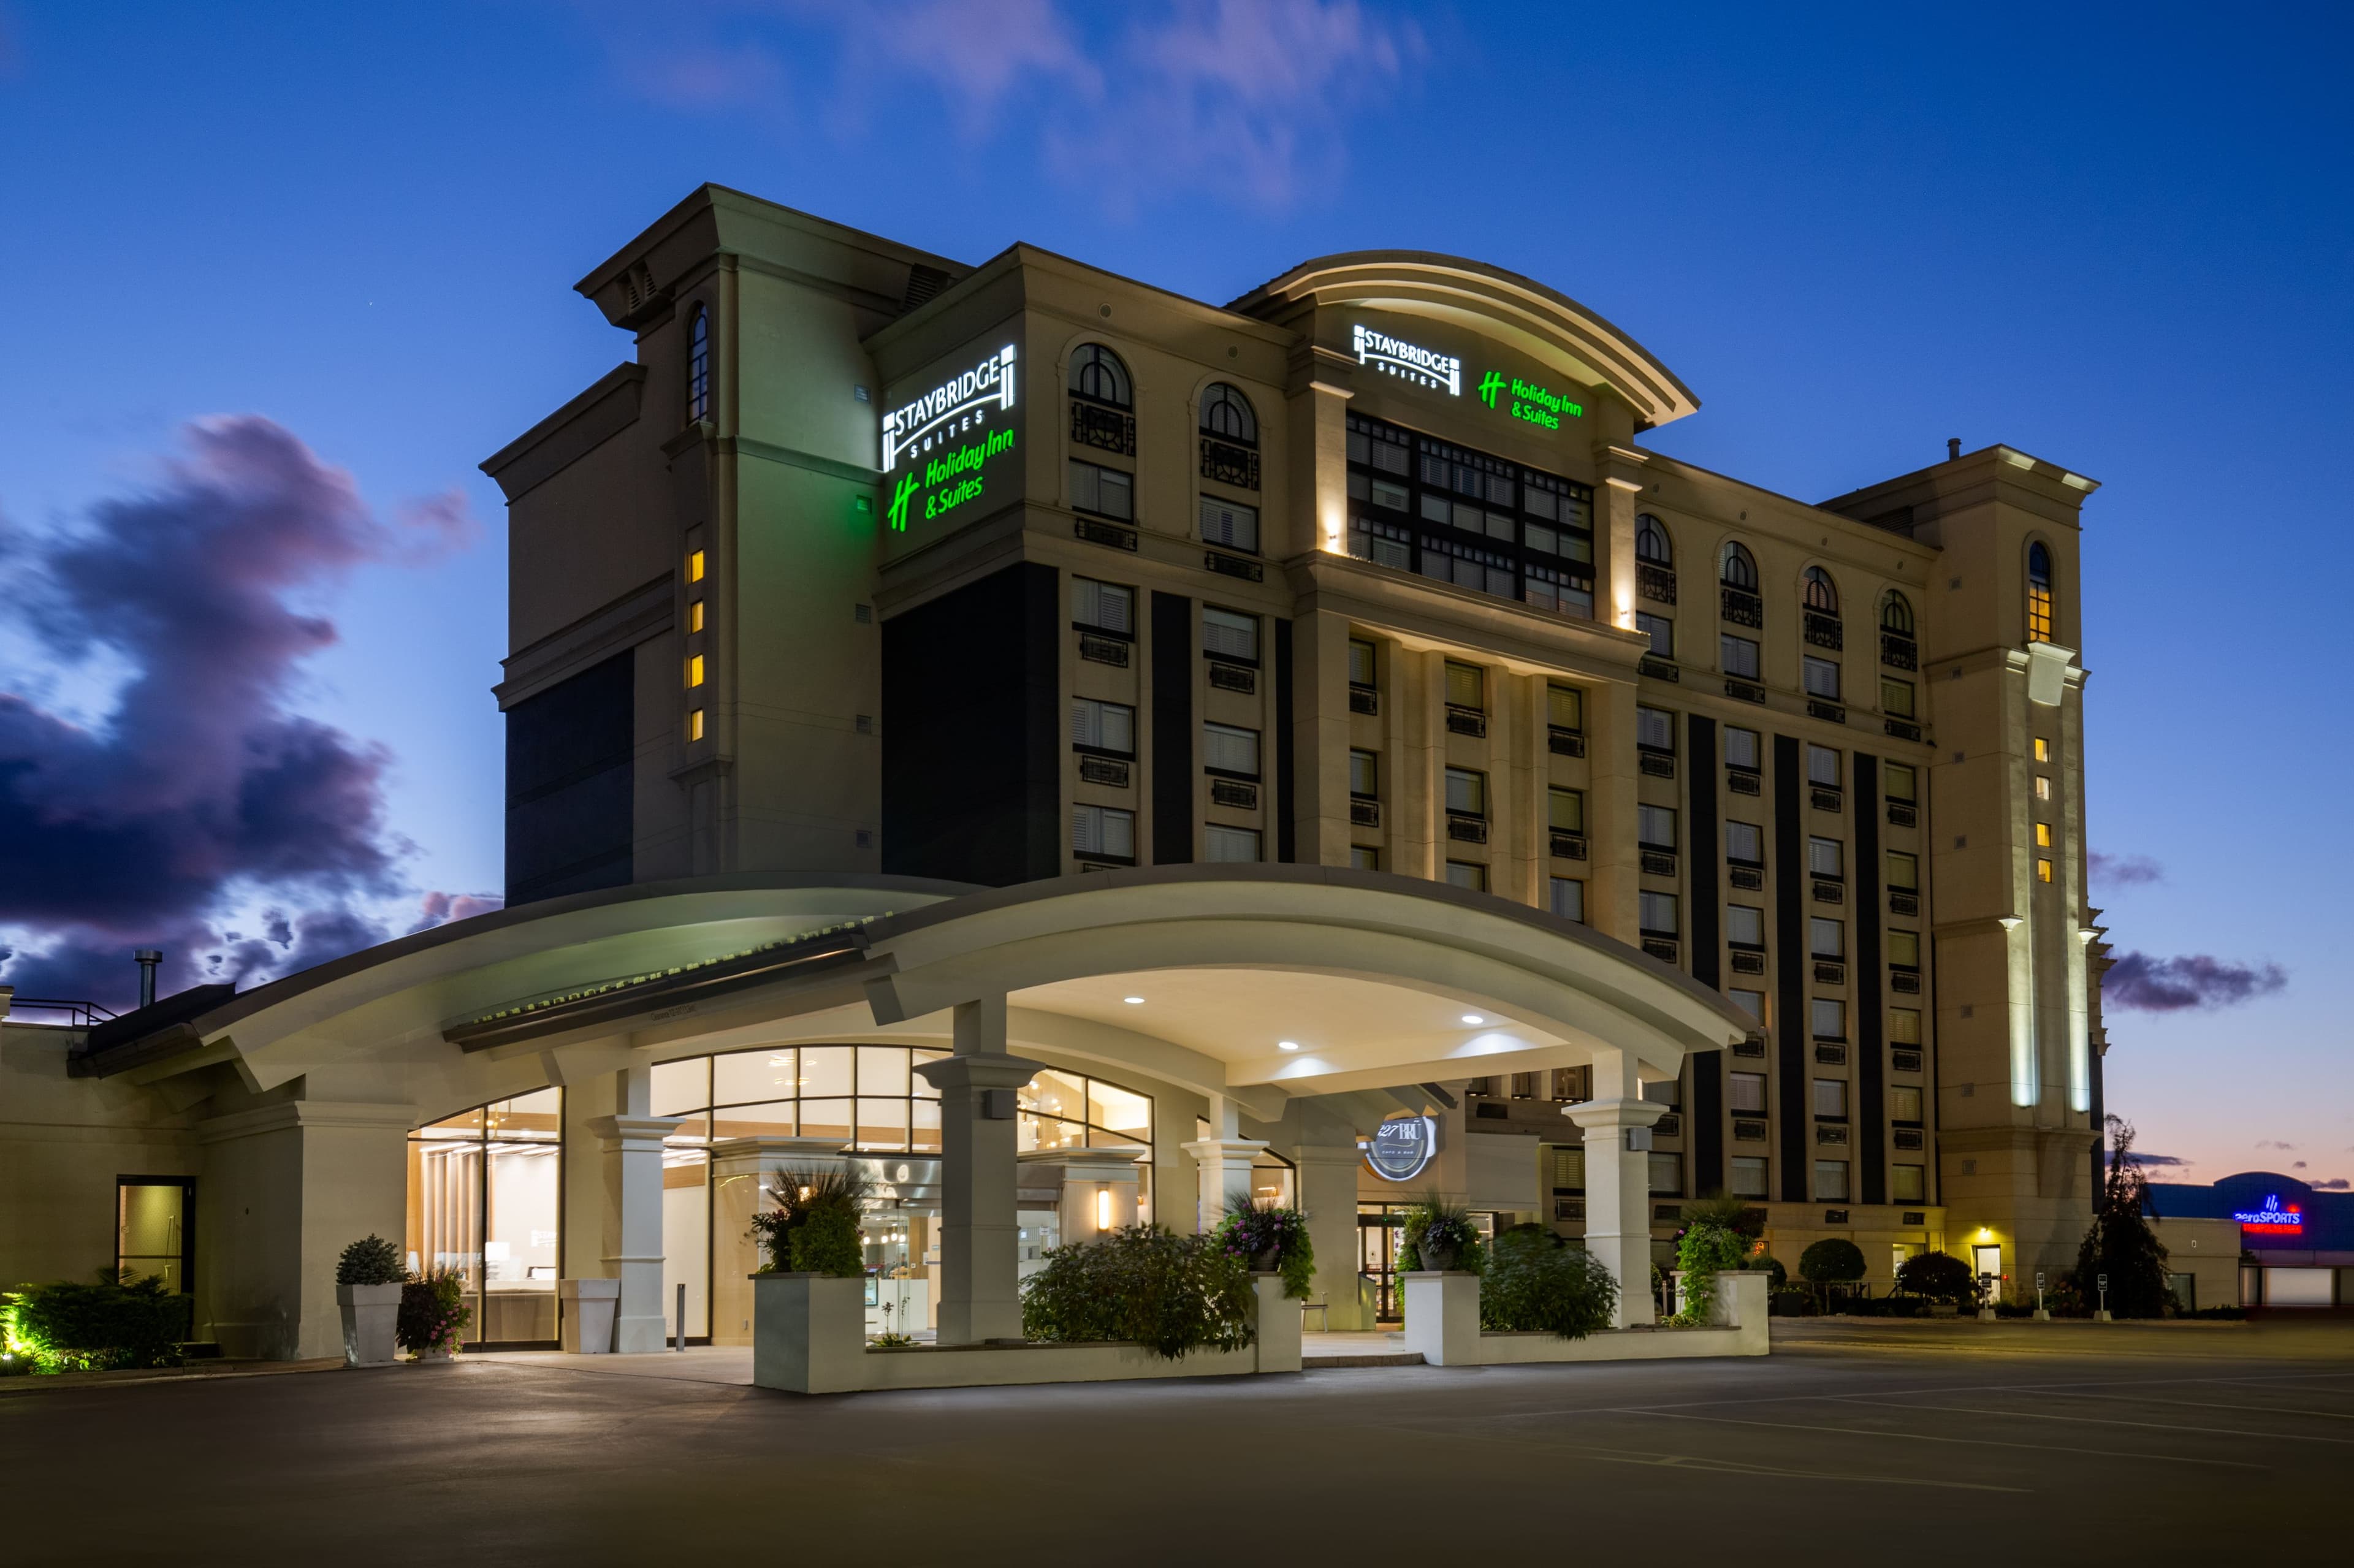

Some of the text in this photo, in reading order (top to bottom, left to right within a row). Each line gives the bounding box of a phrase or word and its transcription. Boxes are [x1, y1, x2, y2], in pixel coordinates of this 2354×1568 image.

[1365, 331, 1450, 373] STAYBRIDGE
[1377, 362, 1437, 389] SUITES
[895, 356, 1000, 436] STAYBRIDGE
[1511, 378, 1583, 417] Holiday Inn
[1511, 402, 1560, 430] & Suites
[910, 409, 985, 459] SUITES
[925, 429, 1015, 488] Holiday Inn
[925, 476, 984, 519] & Suites
[1377, 1124, 1399, 1137] 27
[2235, 1211, 2300, 1224] aeroSPORTS
